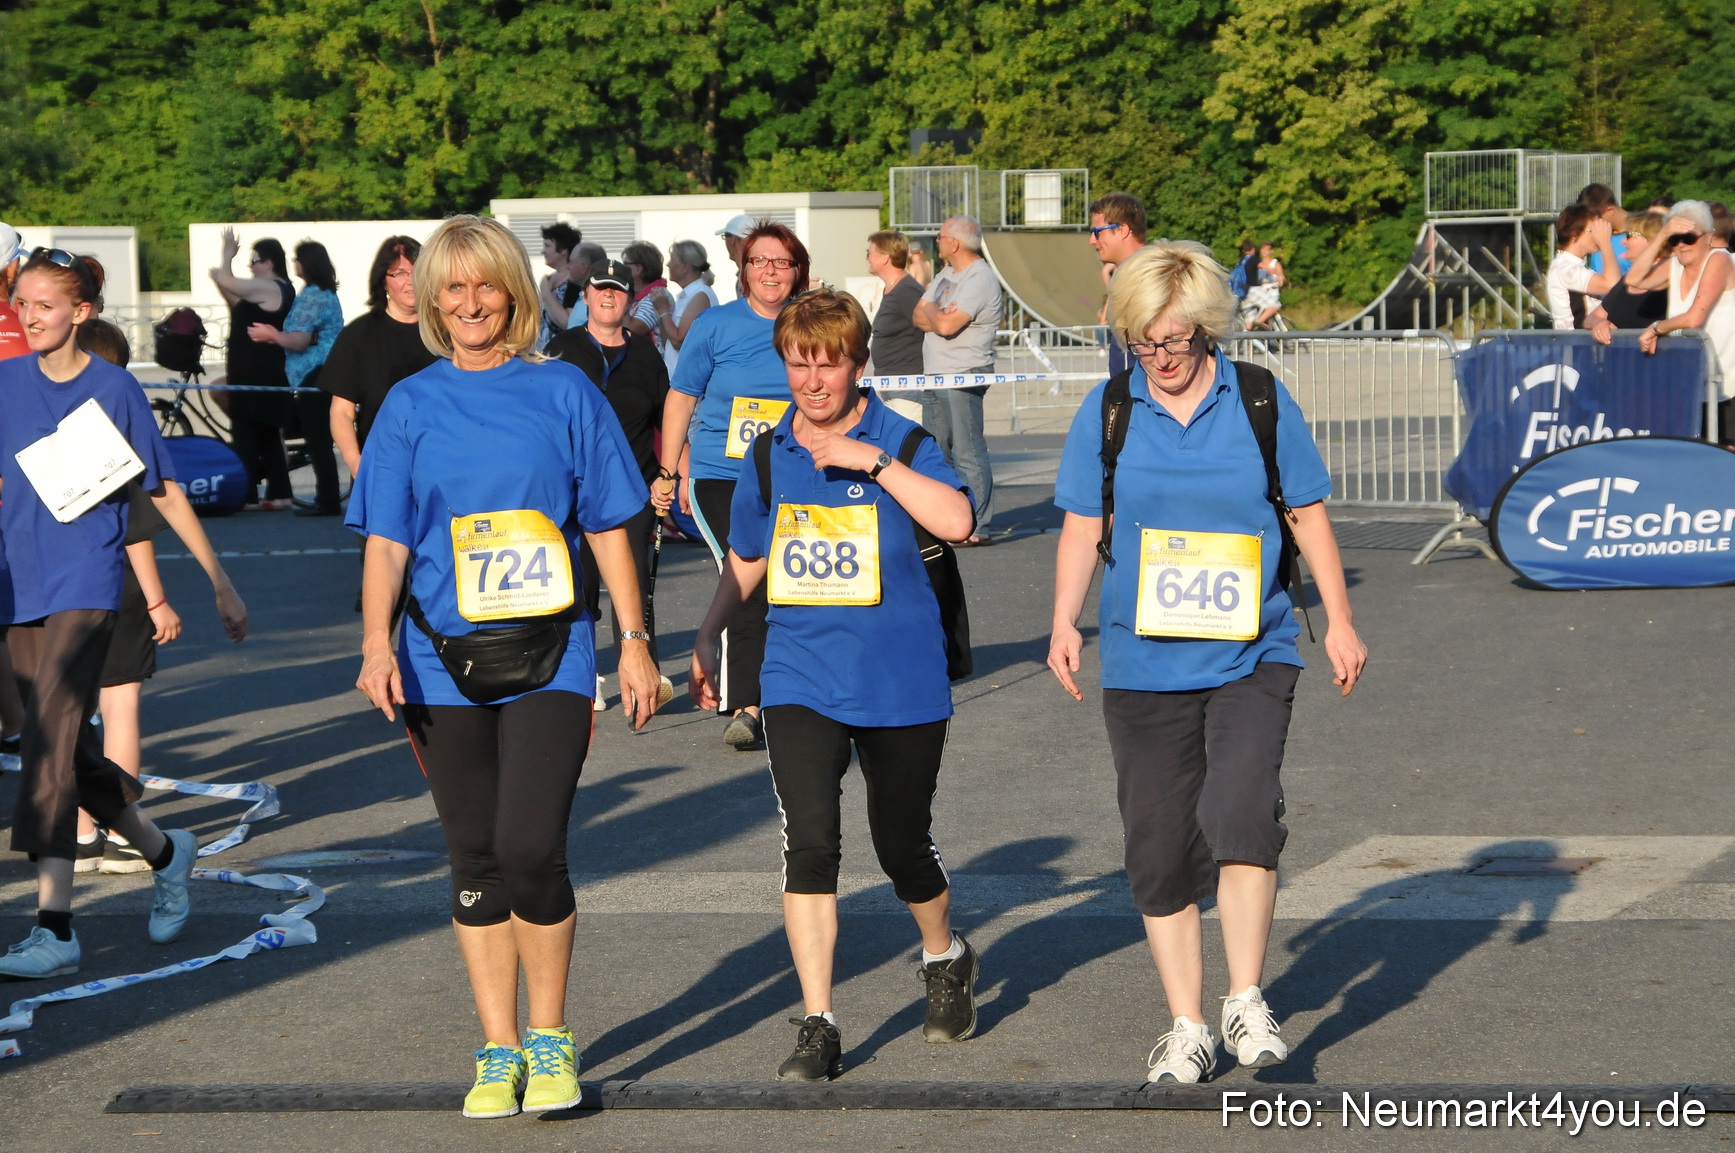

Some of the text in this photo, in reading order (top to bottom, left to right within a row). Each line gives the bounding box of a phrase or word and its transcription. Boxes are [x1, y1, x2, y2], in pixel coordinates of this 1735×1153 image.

[1520, 411, 1651, 458] Fisch
[1566, 503, 1735, 541] Fischer
[783, 539, 860, 580] 688
[1584, 537, 1731, 559] AUTOMOBILE
[468, 546, 553, 593] 724
[479, 603, 509, 611] Lebenshilfe
[1156, 567, 1241, 612] 646
[1163, 611, 1232, 621] Domenique Lehmann
